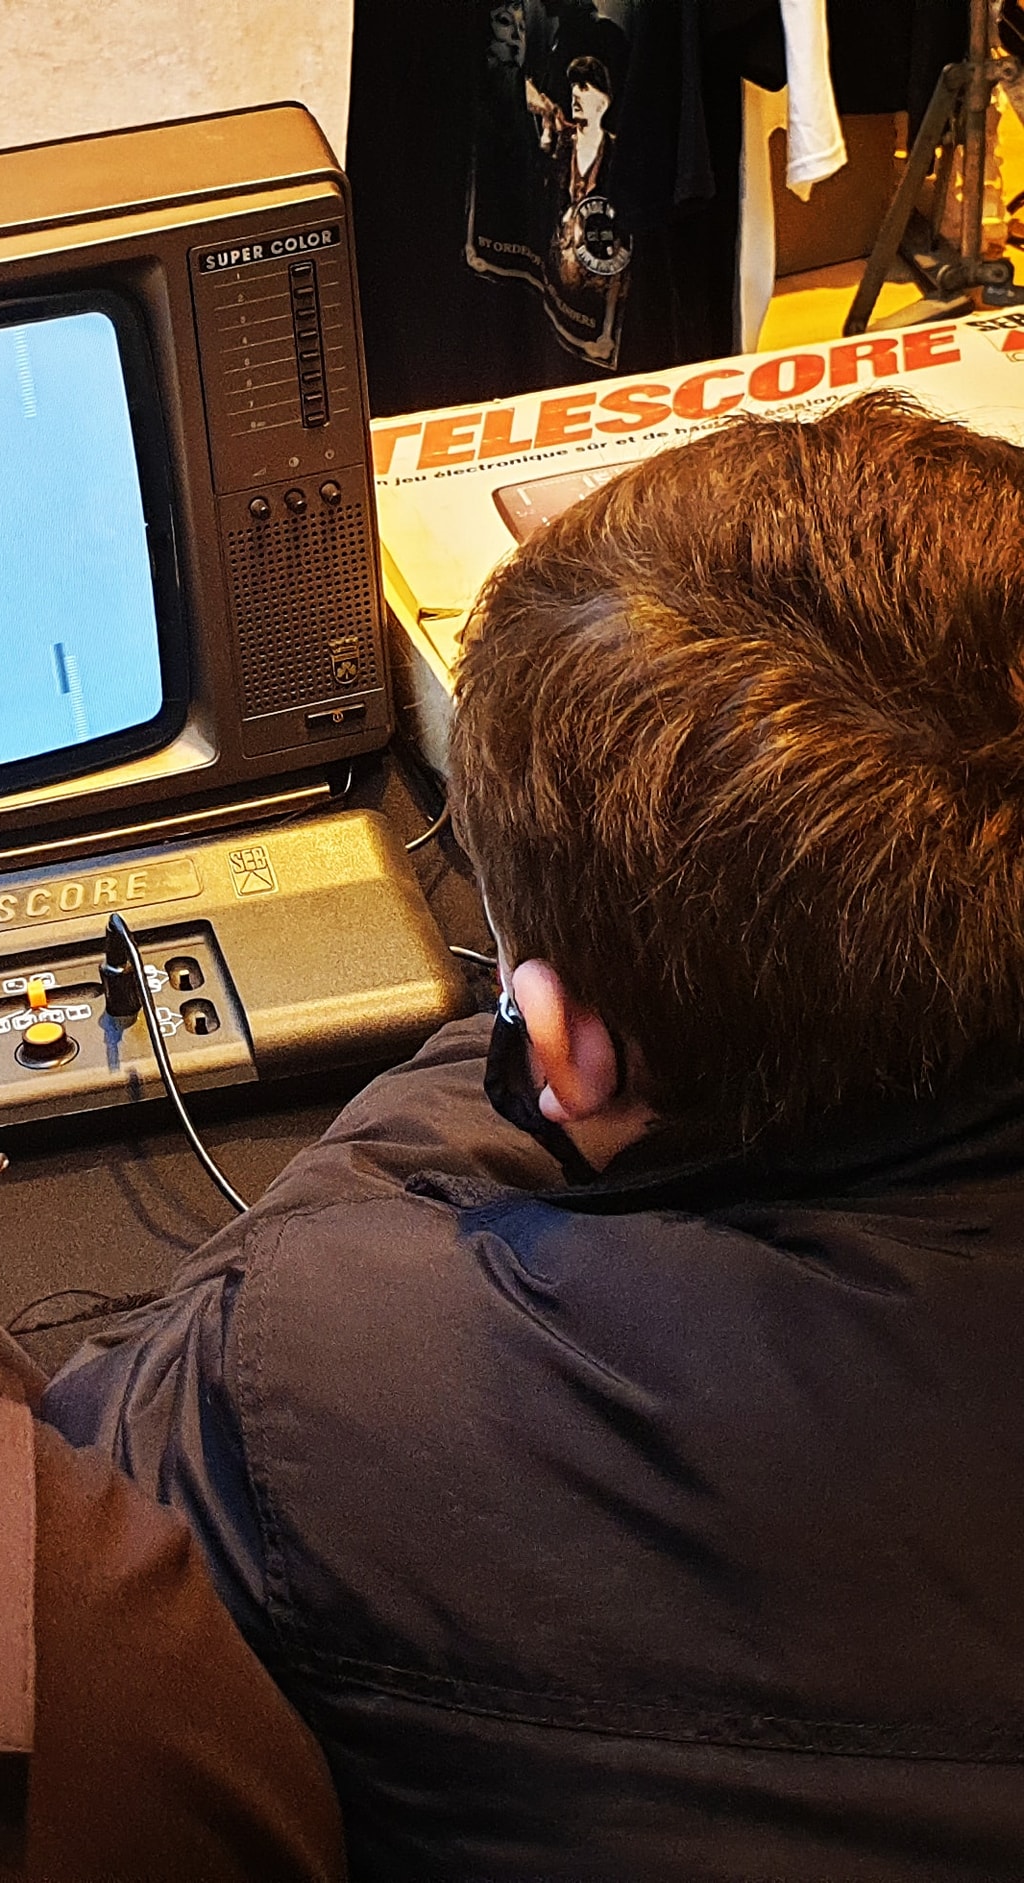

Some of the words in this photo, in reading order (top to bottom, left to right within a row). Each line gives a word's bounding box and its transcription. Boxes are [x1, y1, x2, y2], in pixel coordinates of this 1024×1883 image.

[205, 244, 263, 270] SUPER
[270, 229, 333, 255] COLOR
[372, 325, 962, 477] TELESCORE
[395, 474, 427, 487] jeu
[433, 448, 569, 479] électronique
[575, 440, 608, 452] sûr
[615, 435, 637, 446] et
[641, 428, 669, 442] de
[228, 846, 268, 875] SEB
